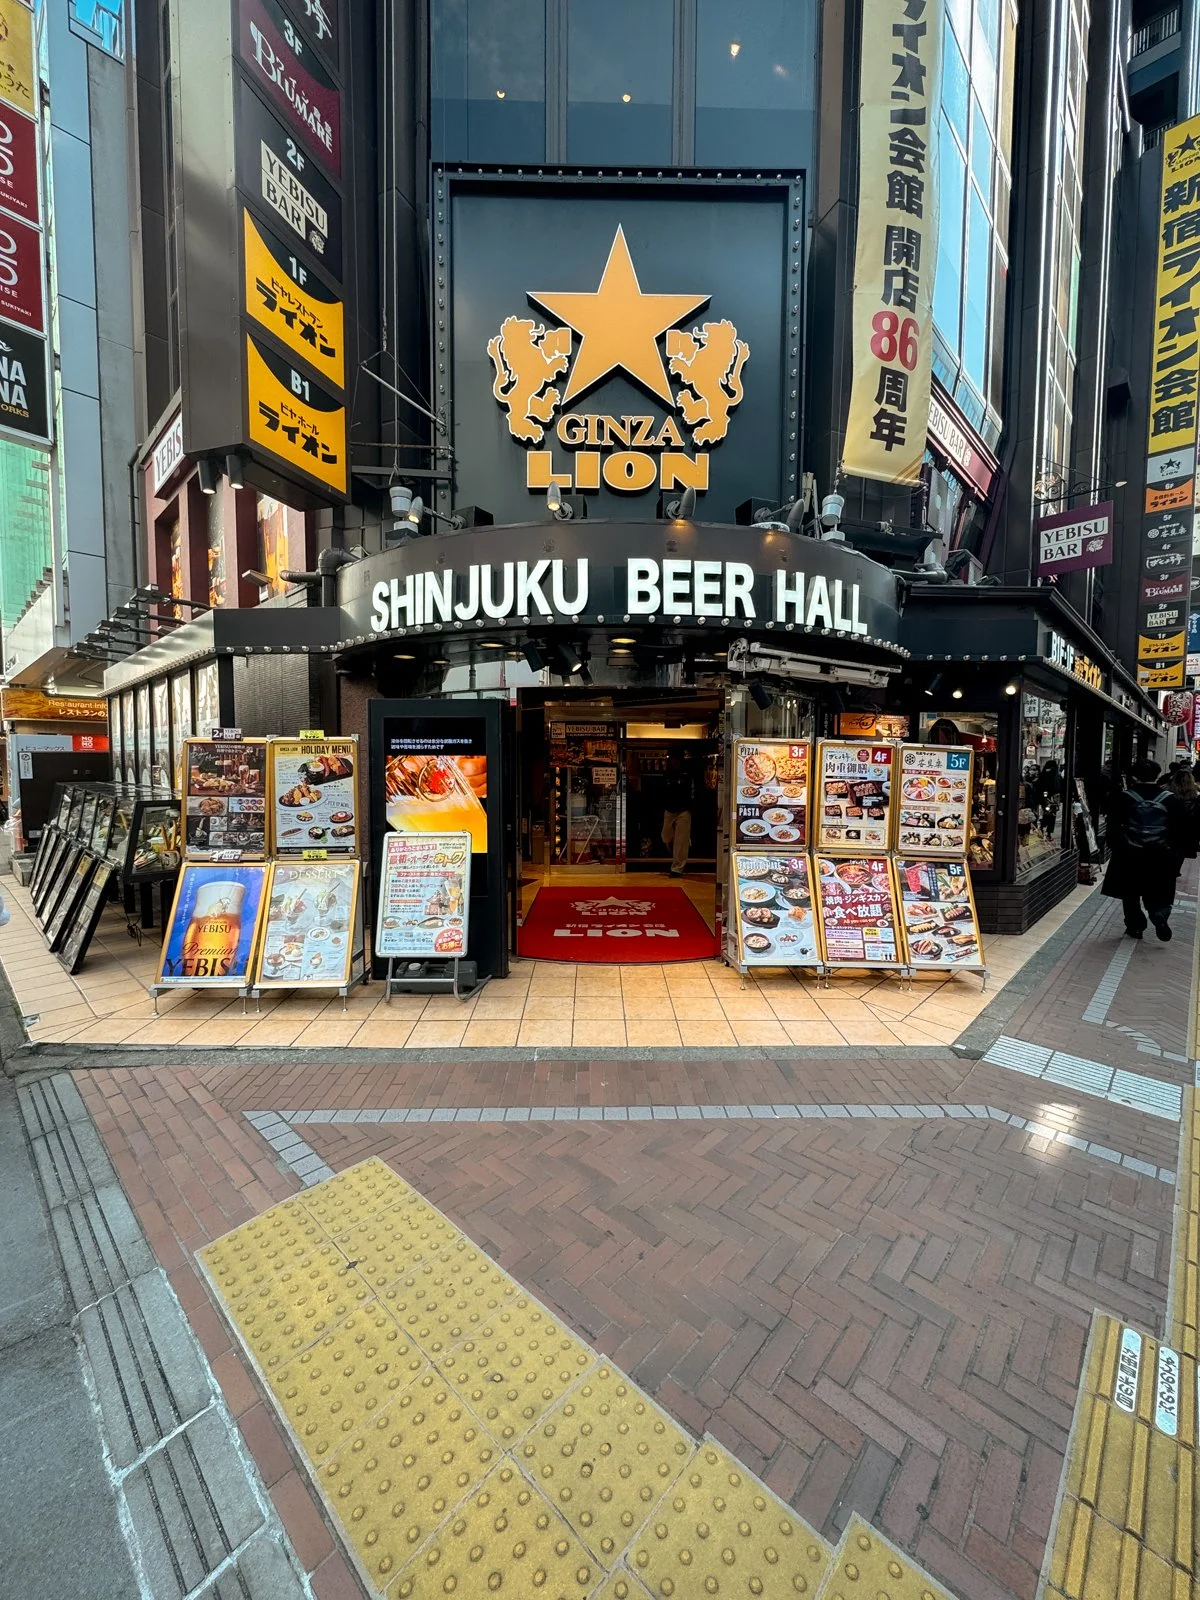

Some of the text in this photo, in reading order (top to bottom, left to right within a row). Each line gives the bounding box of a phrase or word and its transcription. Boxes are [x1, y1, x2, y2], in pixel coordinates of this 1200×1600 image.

[284, 18, 303, 56] 3F
[250, 21, 333, 153] BLUMARE
[286, 138, 305, 172] 2F
[266, 149, 326, 231] YEBISU
[266, 182, 303, 232] BAR
[289, 256, 307, 285] 1F
[1, 300, 32, 316] SUKIYAKI
[271, 277, 323, 329] ビヤレストラン
[256, 277, 336, 358] ライオン
[291, 369, 310, 402] B1
[280, 402, 320, 435] ビヤホール
[259, 400, 338, 465] ライオン
[557, 414, 686, 447] GINZA
[949, 430, 964, 458] BAR
[527, 450, 710, 491] LION
[1150, 496, 1189, 507] ライオン
[1044, 520, 1106, 544] YEBISU
[1044, 543, 1078, 561] BAR
[371, 558, 868, 635] SHINJUKU BEER HALL
[1148, 619, 1165, 627] BAR
[1149, 611, 1177, 620] YEBISU
[1143, 645, 1180, 654] ライオン
[48, 700, 93, 709] Restaurant
[59, 708, 109, 717] レストランの
[213, 729, 224, 738] 2F
[301, 745, 352, 755] HOLIDAY MENU
[740, 747, 759, 756] PIZZA
[791, 745, 805, 757] 3F
[874, 751, 888, 762] 4F
[950, 753, 967, 768] 5F
[739, 807, 760, 817] PASTA
[791, 858, 804, 870] 3F
[871, 861, 884, 872] 4F
[949, 864, 962, 875] 5F
[289, 869, 339, 880] DESSERT
[834, 904, 883, 919] 食べ放題
[198, 924, 232, 934] YEBISU
[553, 929, 680, 938] LION
[166, 958, 249, 977] YEBIS
